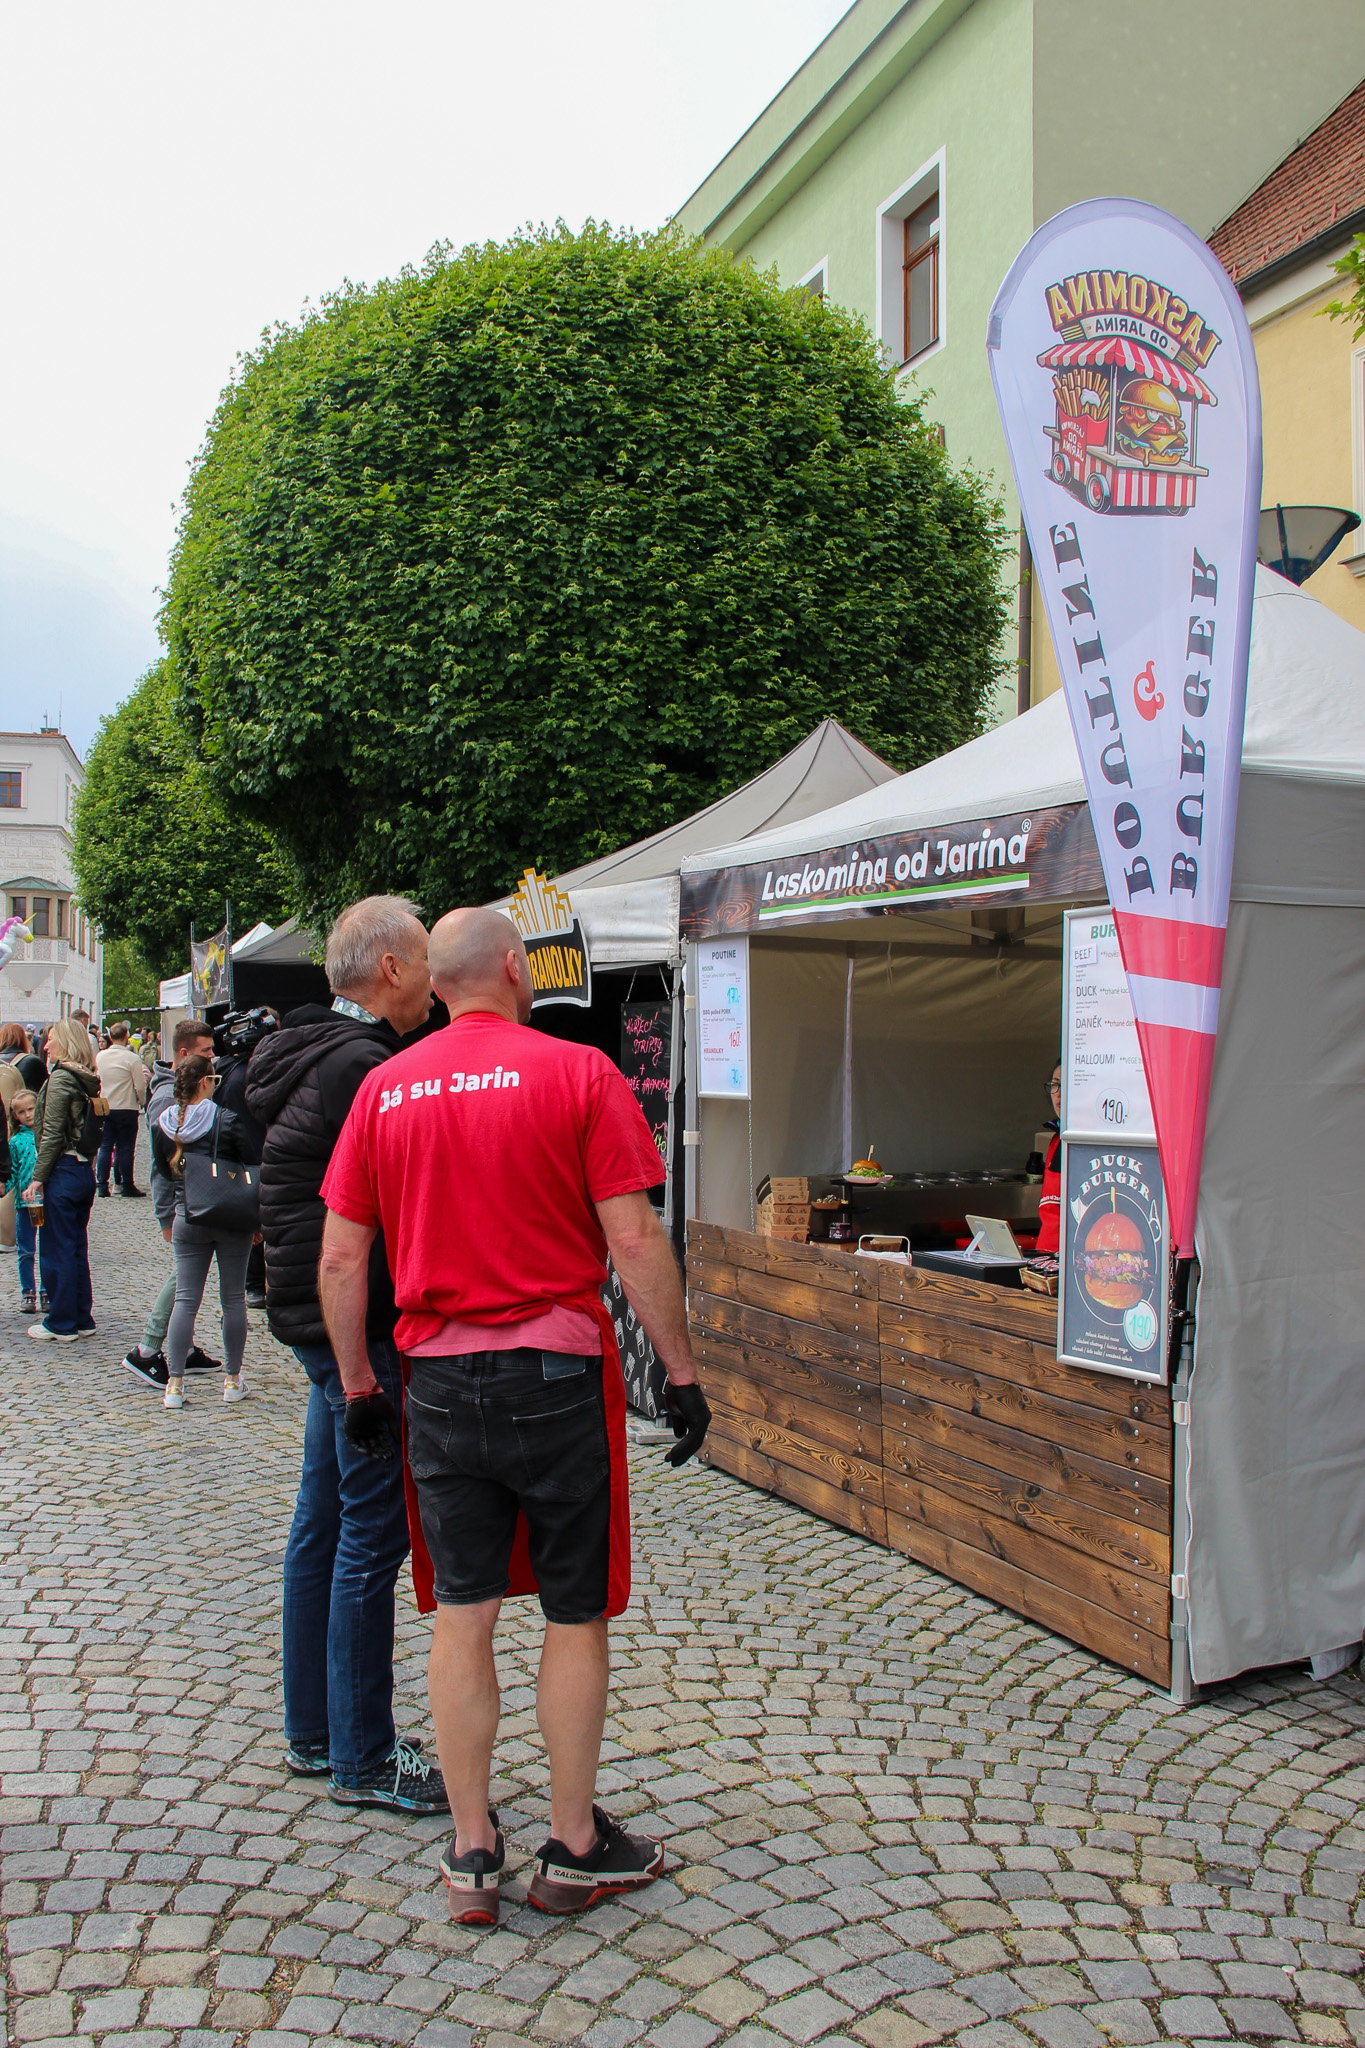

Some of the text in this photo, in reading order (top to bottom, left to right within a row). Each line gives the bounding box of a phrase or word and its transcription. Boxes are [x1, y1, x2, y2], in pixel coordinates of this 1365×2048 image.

[761, 851, 887, 901] Laskomina
[894, 842, 928, 881] od
[712, 949, 736, 960] POUTINE
[1074, 948, 1093, 960] BEEF
[1076, 985, 1097, 997] DUCK
[1076, 1016, 1102, 1029] DANĚK
[1075, 1054, 1115, 1066] HALLOUMI
[379, 1066, 520, 1113] Já su Jarin
[1089, 1154, 1143, 1175] DUCK
[1080, 1171, 1150, 1201] BURGER
[553, 1869, 594, 1882] SALOMON
